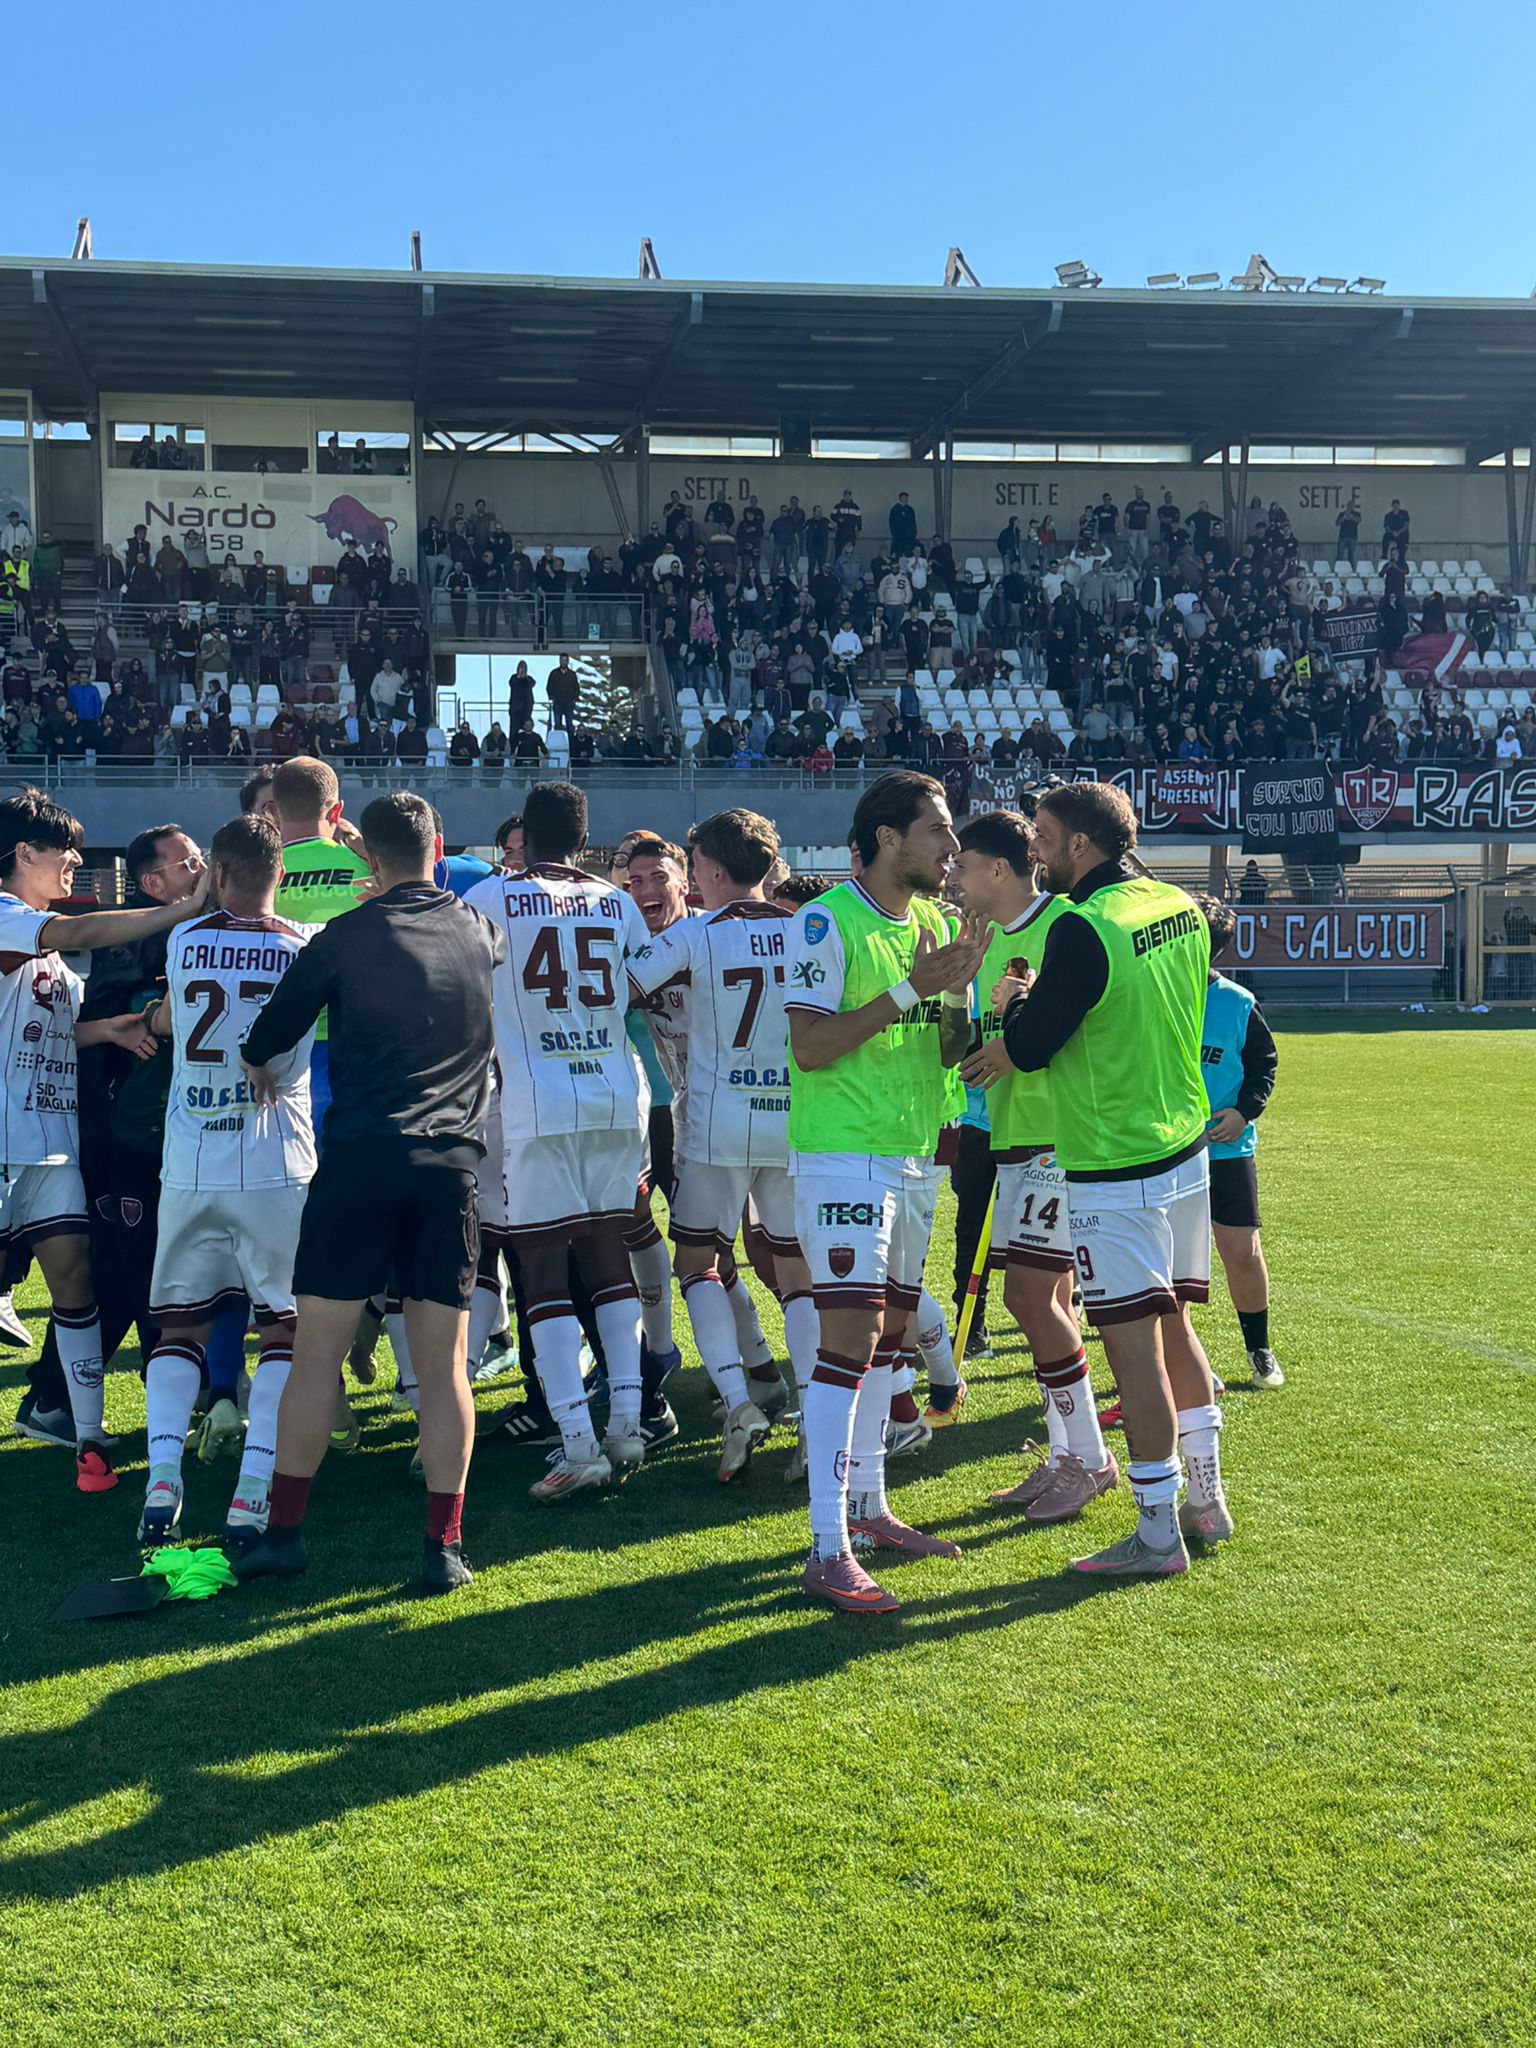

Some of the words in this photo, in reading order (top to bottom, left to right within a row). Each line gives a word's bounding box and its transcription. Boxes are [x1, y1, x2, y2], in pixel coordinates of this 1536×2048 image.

[192, 486, 231, 498] A.C.
[684, 477, 733, 500] SETT.
[739, 477, 750, 500] D
[996, 483, 1042, 506] SETT.
[1048, 483, 1059, 506] E
[1300, 486, 1345, 509] SETT.
[1352, 486, 1361, 508] E
[145, 500, 276, 529] Nardò
[994, 784, 1016, 799] NO
[1253, 777, 1324, 806] SORCIO
[1246, 813, 1285, 837] CON
[1131, 908, 1200, 957] GIEMME
[1285, 914, 1427, 960] CALCIO!
[182, 945, 296, 973] CALDERON
[523, 927, 620, 1013] 45
[1020, 1193, 1060, 1229] 14
[1076, 1245, 1095, 1281] 9
